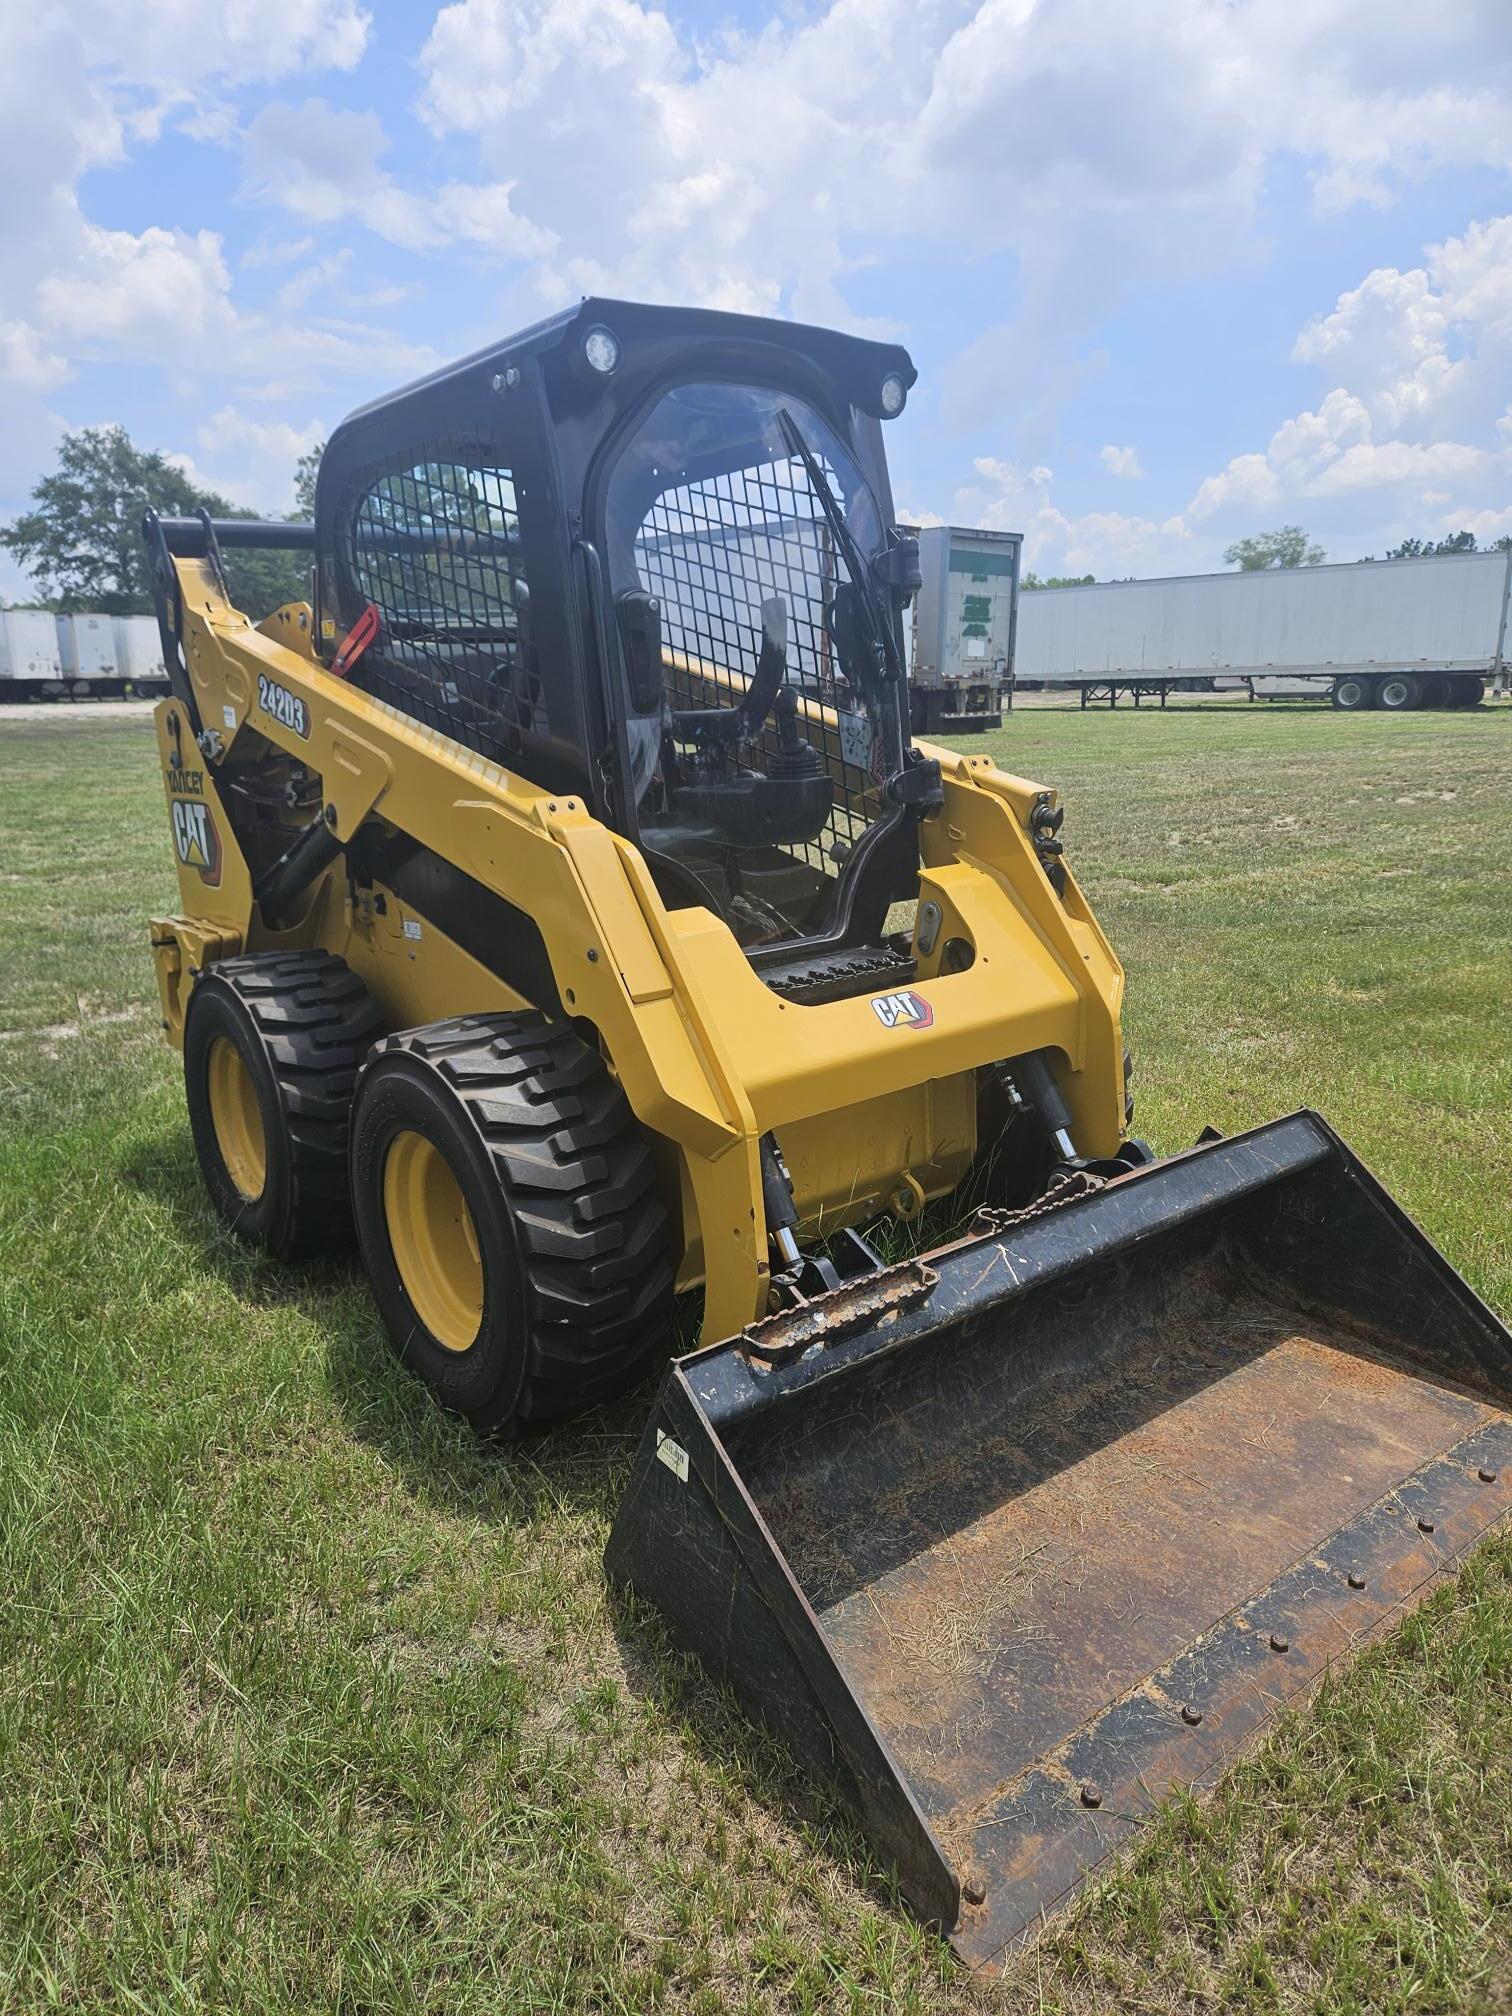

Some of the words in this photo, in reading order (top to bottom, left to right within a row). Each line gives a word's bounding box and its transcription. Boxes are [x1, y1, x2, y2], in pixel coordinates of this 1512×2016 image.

[259, 675, 304, 734] 242D3
[172, 800, 210, 866] CAT
[871, 992, 921, 1027] CAT
